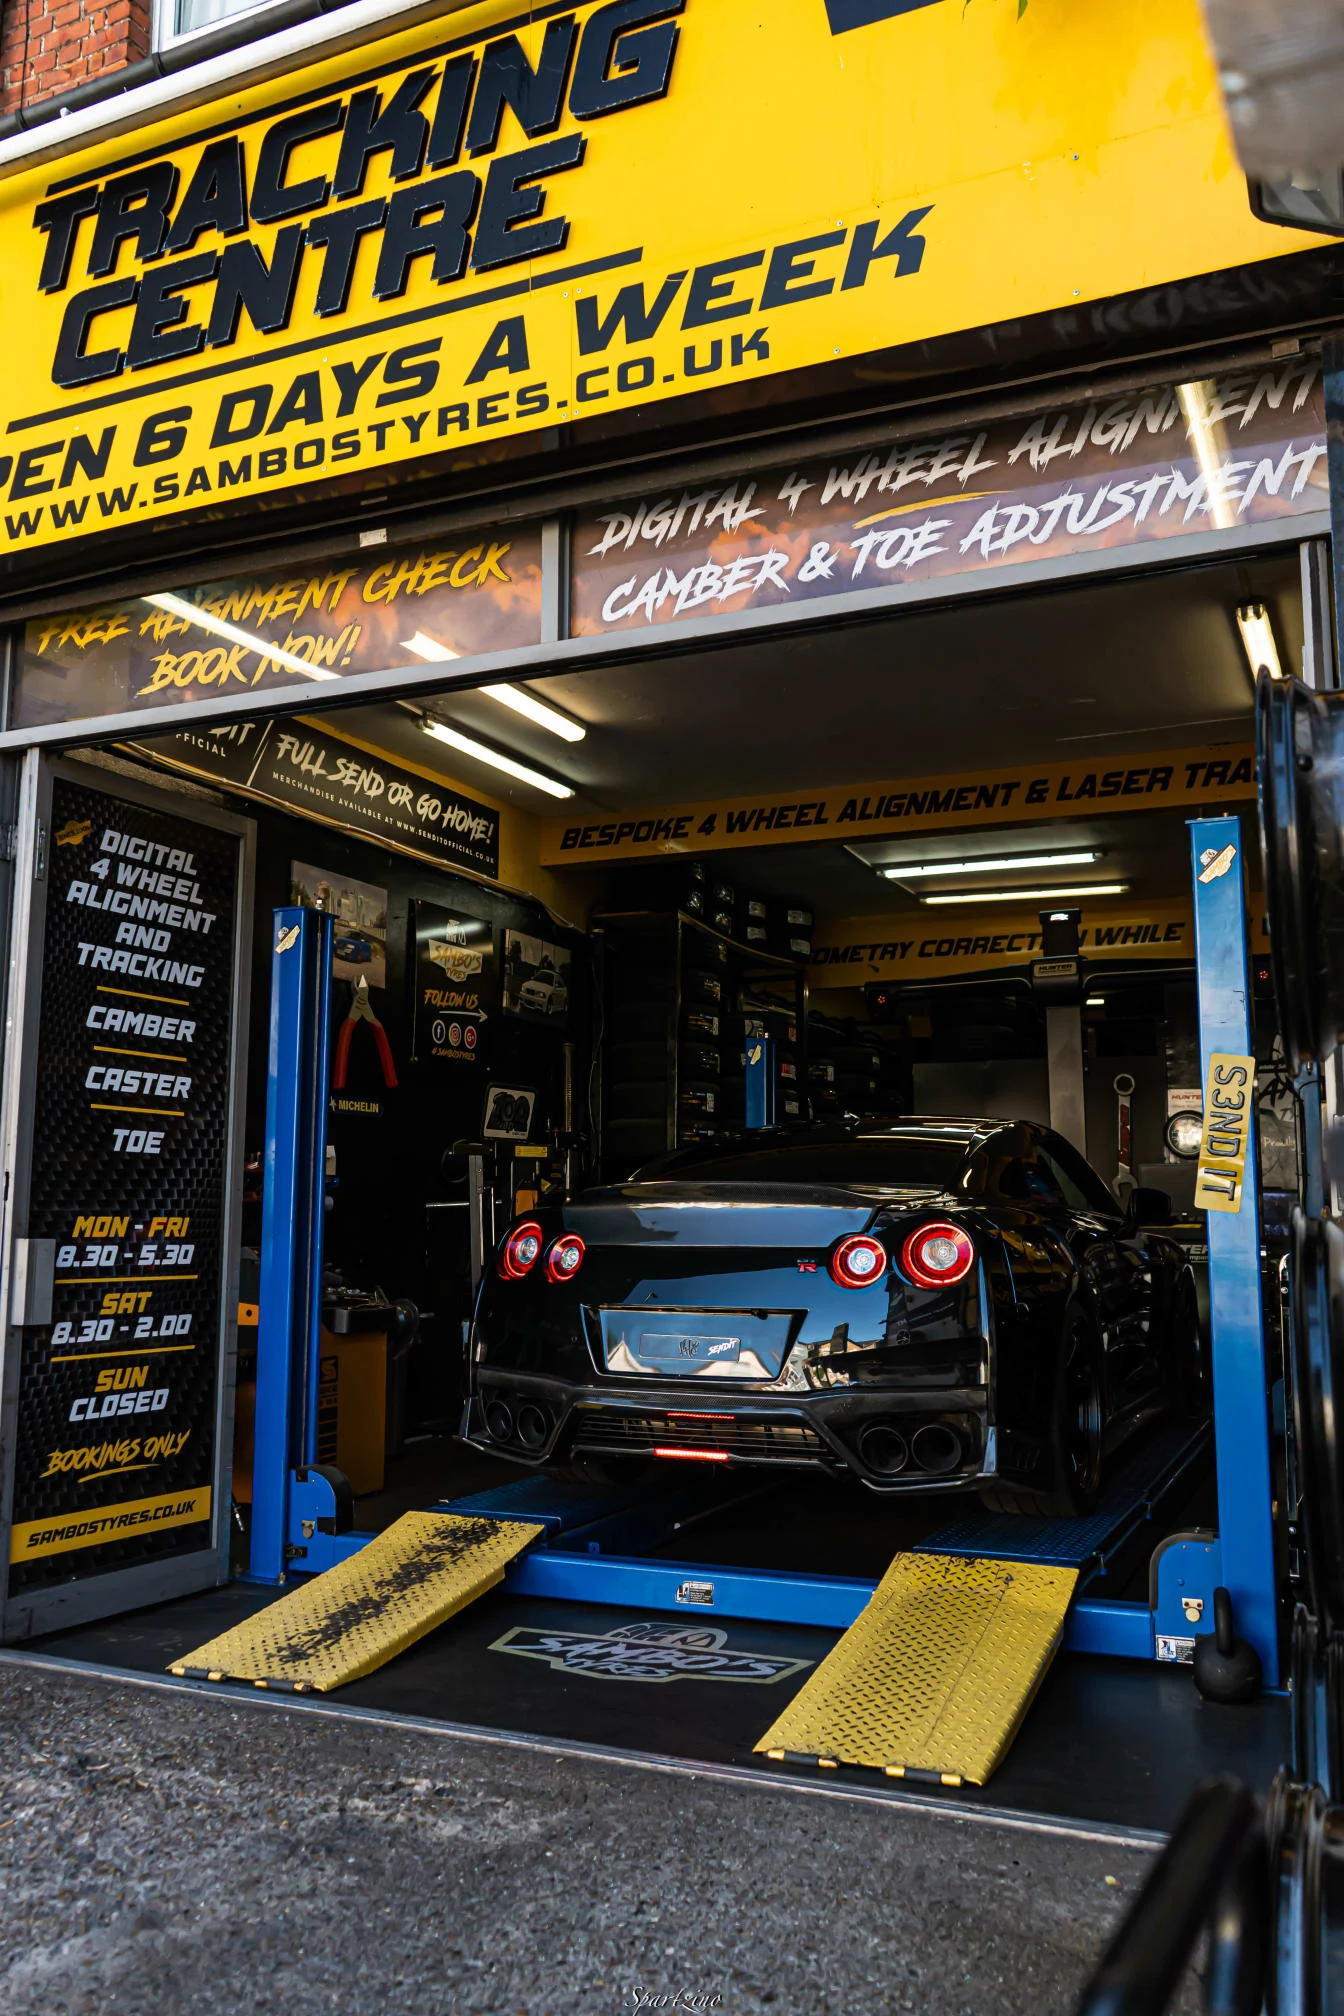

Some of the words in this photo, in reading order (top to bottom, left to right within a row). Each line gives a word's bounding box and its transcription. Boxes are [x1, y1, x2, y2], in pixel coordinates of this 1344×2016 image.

[33, 0, 684, 292] TRACKING
[51, 132, 588, 390] CENTRE
[133, 404, 193, 468] 6
[209, 336, 443, 450] DAYS
[465, 315, 531, 384] A
[575, 204, 936, 356] WEEK
[4, 327, 771, 540] WWW.SAMBOSTYRES.CO.UK
[587, 480, 763, 557] DIGITAL
[779, 478, 816, 516] 4
[819, 431, 998, 510] WHEEL
[601, 548, 790, 624] CAMBER
[798, 540, 838, 582] &
[851, 516, 953, 584] TOE
[960, 443, 1328, 560] ADJUSTMENT
[37, 610, 132, 655] FREE
[361, 541, 514, 606] CHECK
[136, 645, 251, 696] BOOK
[276, 733, 328, 777] FULL
[326, 757, 386, 799] SEND
[387, 782, 414, 814] OR
[416, 792, 441, 823] GO
[442, 803, 495, 845] HOME!
[560, 816, 693, 850] BESPOKE
[697, 813, 715, 836] 4
[725, 800, 828, 832] WHEEL
[837, 781, 1017, 823] ALIGNMENT
[1025, 777, 1048, 804] &
[1056, 765, 1171, 800] LASER
[1185, 757, 1257, 789] TRA
[272, 771, 336, 802] MERCHANDISE
[338, 797, 383, 822] AVAILABLE
[384, 815, 395, 825] AT
[396, 819, 496, 865] WWW.SENDITOFFICIAL.CO.UK
[100, 829, 198, 876] DIGITAL
[90, 858, 110, 881] 4
[117, 862, 204, 905] WHEEL
[66, 880, 216, 934] ALIGNMENT
[115, 922, 172, 953] AND
[1094, 922, 1186, 946] WHILE
[77, 942, 206, 988] TRACKING
[432, 943, 481, 973] SAMBO'S
[424, 989, 465, 1008] FOLLOW
[465, 993, 479, 1010] US
[86, 1005, 197, 1042] CAMBER
[85, 1066, 192, 1099] CASTER
[338, 1099, 379, 1113] MICHELIN
[1207, 1064, 1247, 1157] S3ND
[112, 1128, 165, 1154] TOE
[1202, 1168, 1237, 1201] IT
[72, 1216, 130, 1238] MON
[148, 1217, 190, 1238] FRI
[56, 1245, 118, 1268] 8.30
[137, 1244, 195, 1267] 5.30
[100, 1291, 152, 1316] SAT
[51, 1318, 112, 1345] 8.30
[133, 1313, 192, 1339] 2.00
[95, 1366, 149, 1392] SUN
[69, 1389, 169, 1422] CLOSED
[39, 1439, 141, 1479] BOOKINGS
[143, 1429, 191, 1456] ONLY
[27, 1500, 196, 1548] SAMBOSTYRES.CO.UK
[503, 1636, 786, 1677] SAMBO'S
